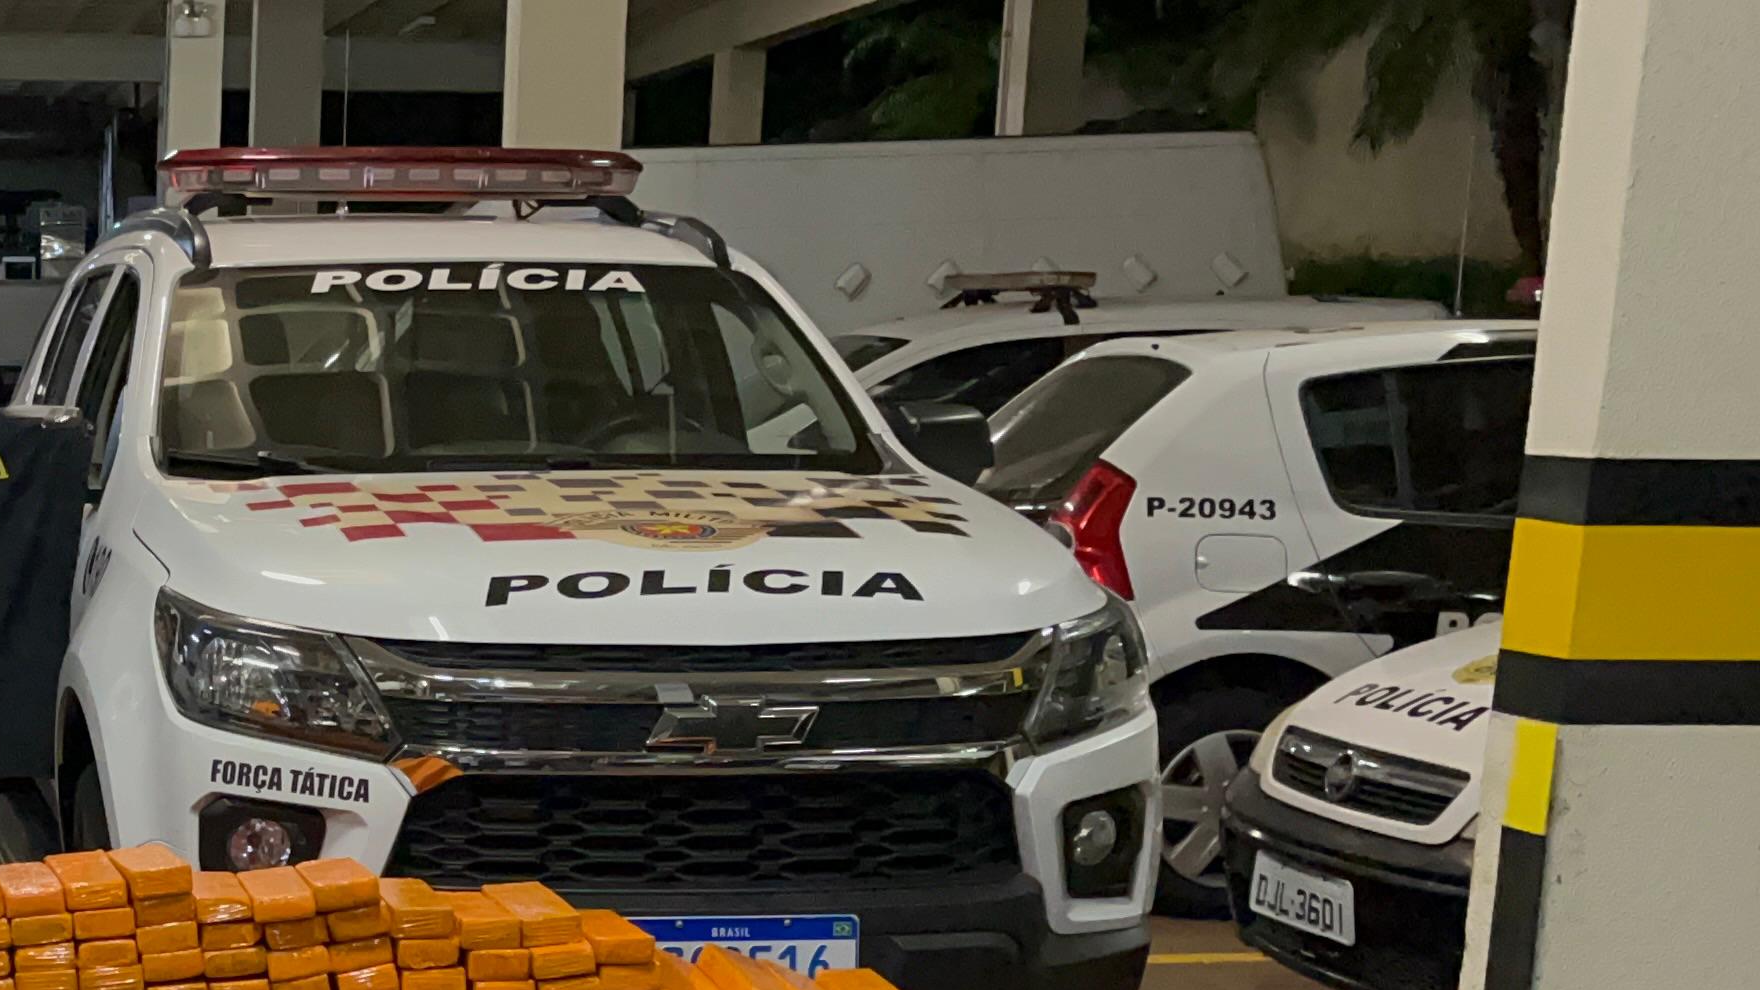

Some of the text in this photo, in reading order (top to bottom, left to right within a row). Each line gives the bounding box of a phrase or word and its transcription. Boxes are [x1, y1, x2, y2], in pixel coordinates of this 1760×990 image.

[311, 263, 646, 293] POLÍCIA
[1146, 496, 1277, 520] P-20943
[485, 564, 925, 607] POLÍCIA
[1334, 683, 1490, 731] POLÍCIA
[211, 759, 369, 803] FORÇA TÁTICA
[711, 927, 750, 938] BRASIL
